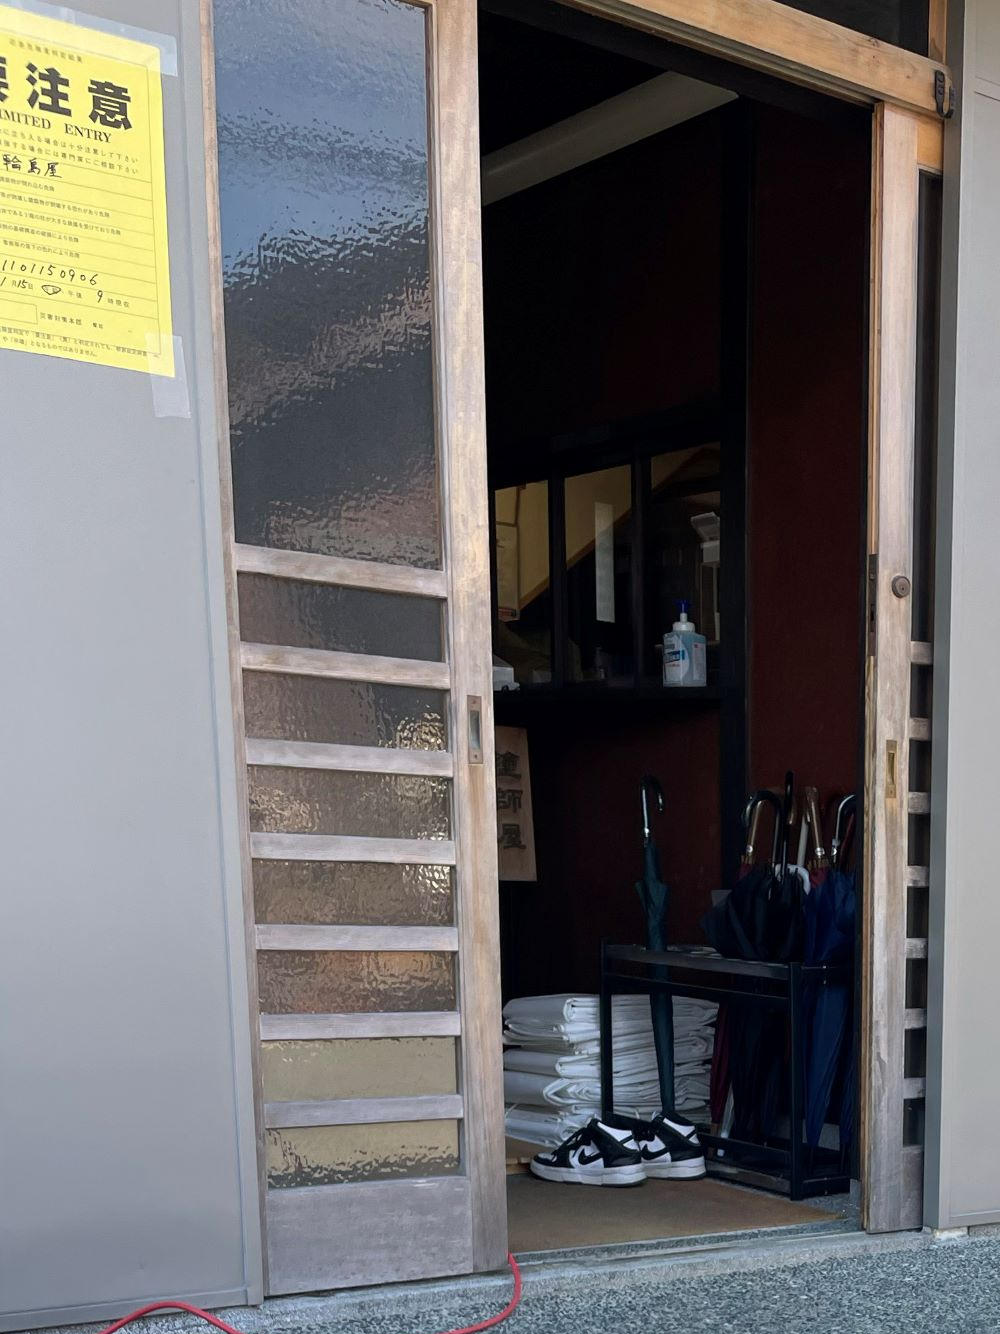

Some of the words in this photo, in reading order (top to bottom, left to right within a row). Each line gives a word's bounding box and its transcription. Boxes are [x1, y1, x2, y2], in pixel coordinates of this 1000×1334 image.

[0, 55, 132, 131] 注意
[64, 123, 112, 143] ENTRY
[3, 153, 62, 178] 輪島屋
